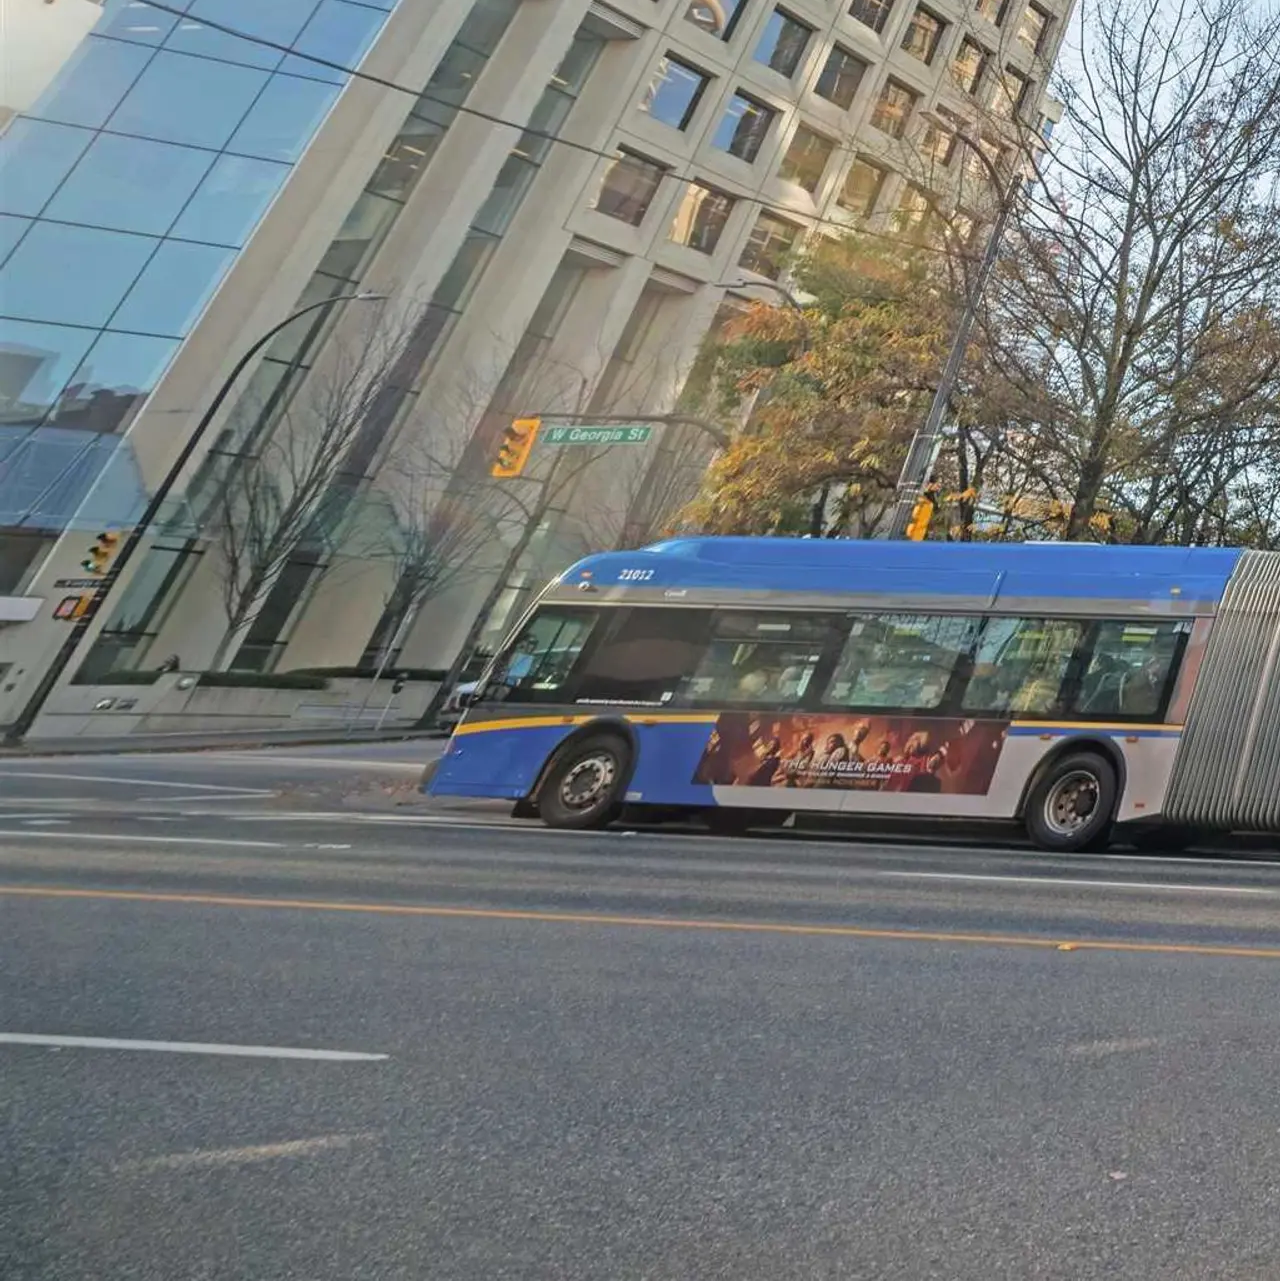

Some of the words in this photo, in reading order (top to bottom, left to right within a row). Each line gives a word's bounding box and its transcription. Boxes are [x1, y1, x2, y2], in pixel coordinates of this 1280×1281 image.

[551, 428, 567, 440] W
[569, 428, 623, 442] Georgia
[628, 428, 645, 440] St
[617, 569, 655, 580] 21012
[810, 760, 864, 771] HUNGER
[866, 762, 912, 773] GAMES
